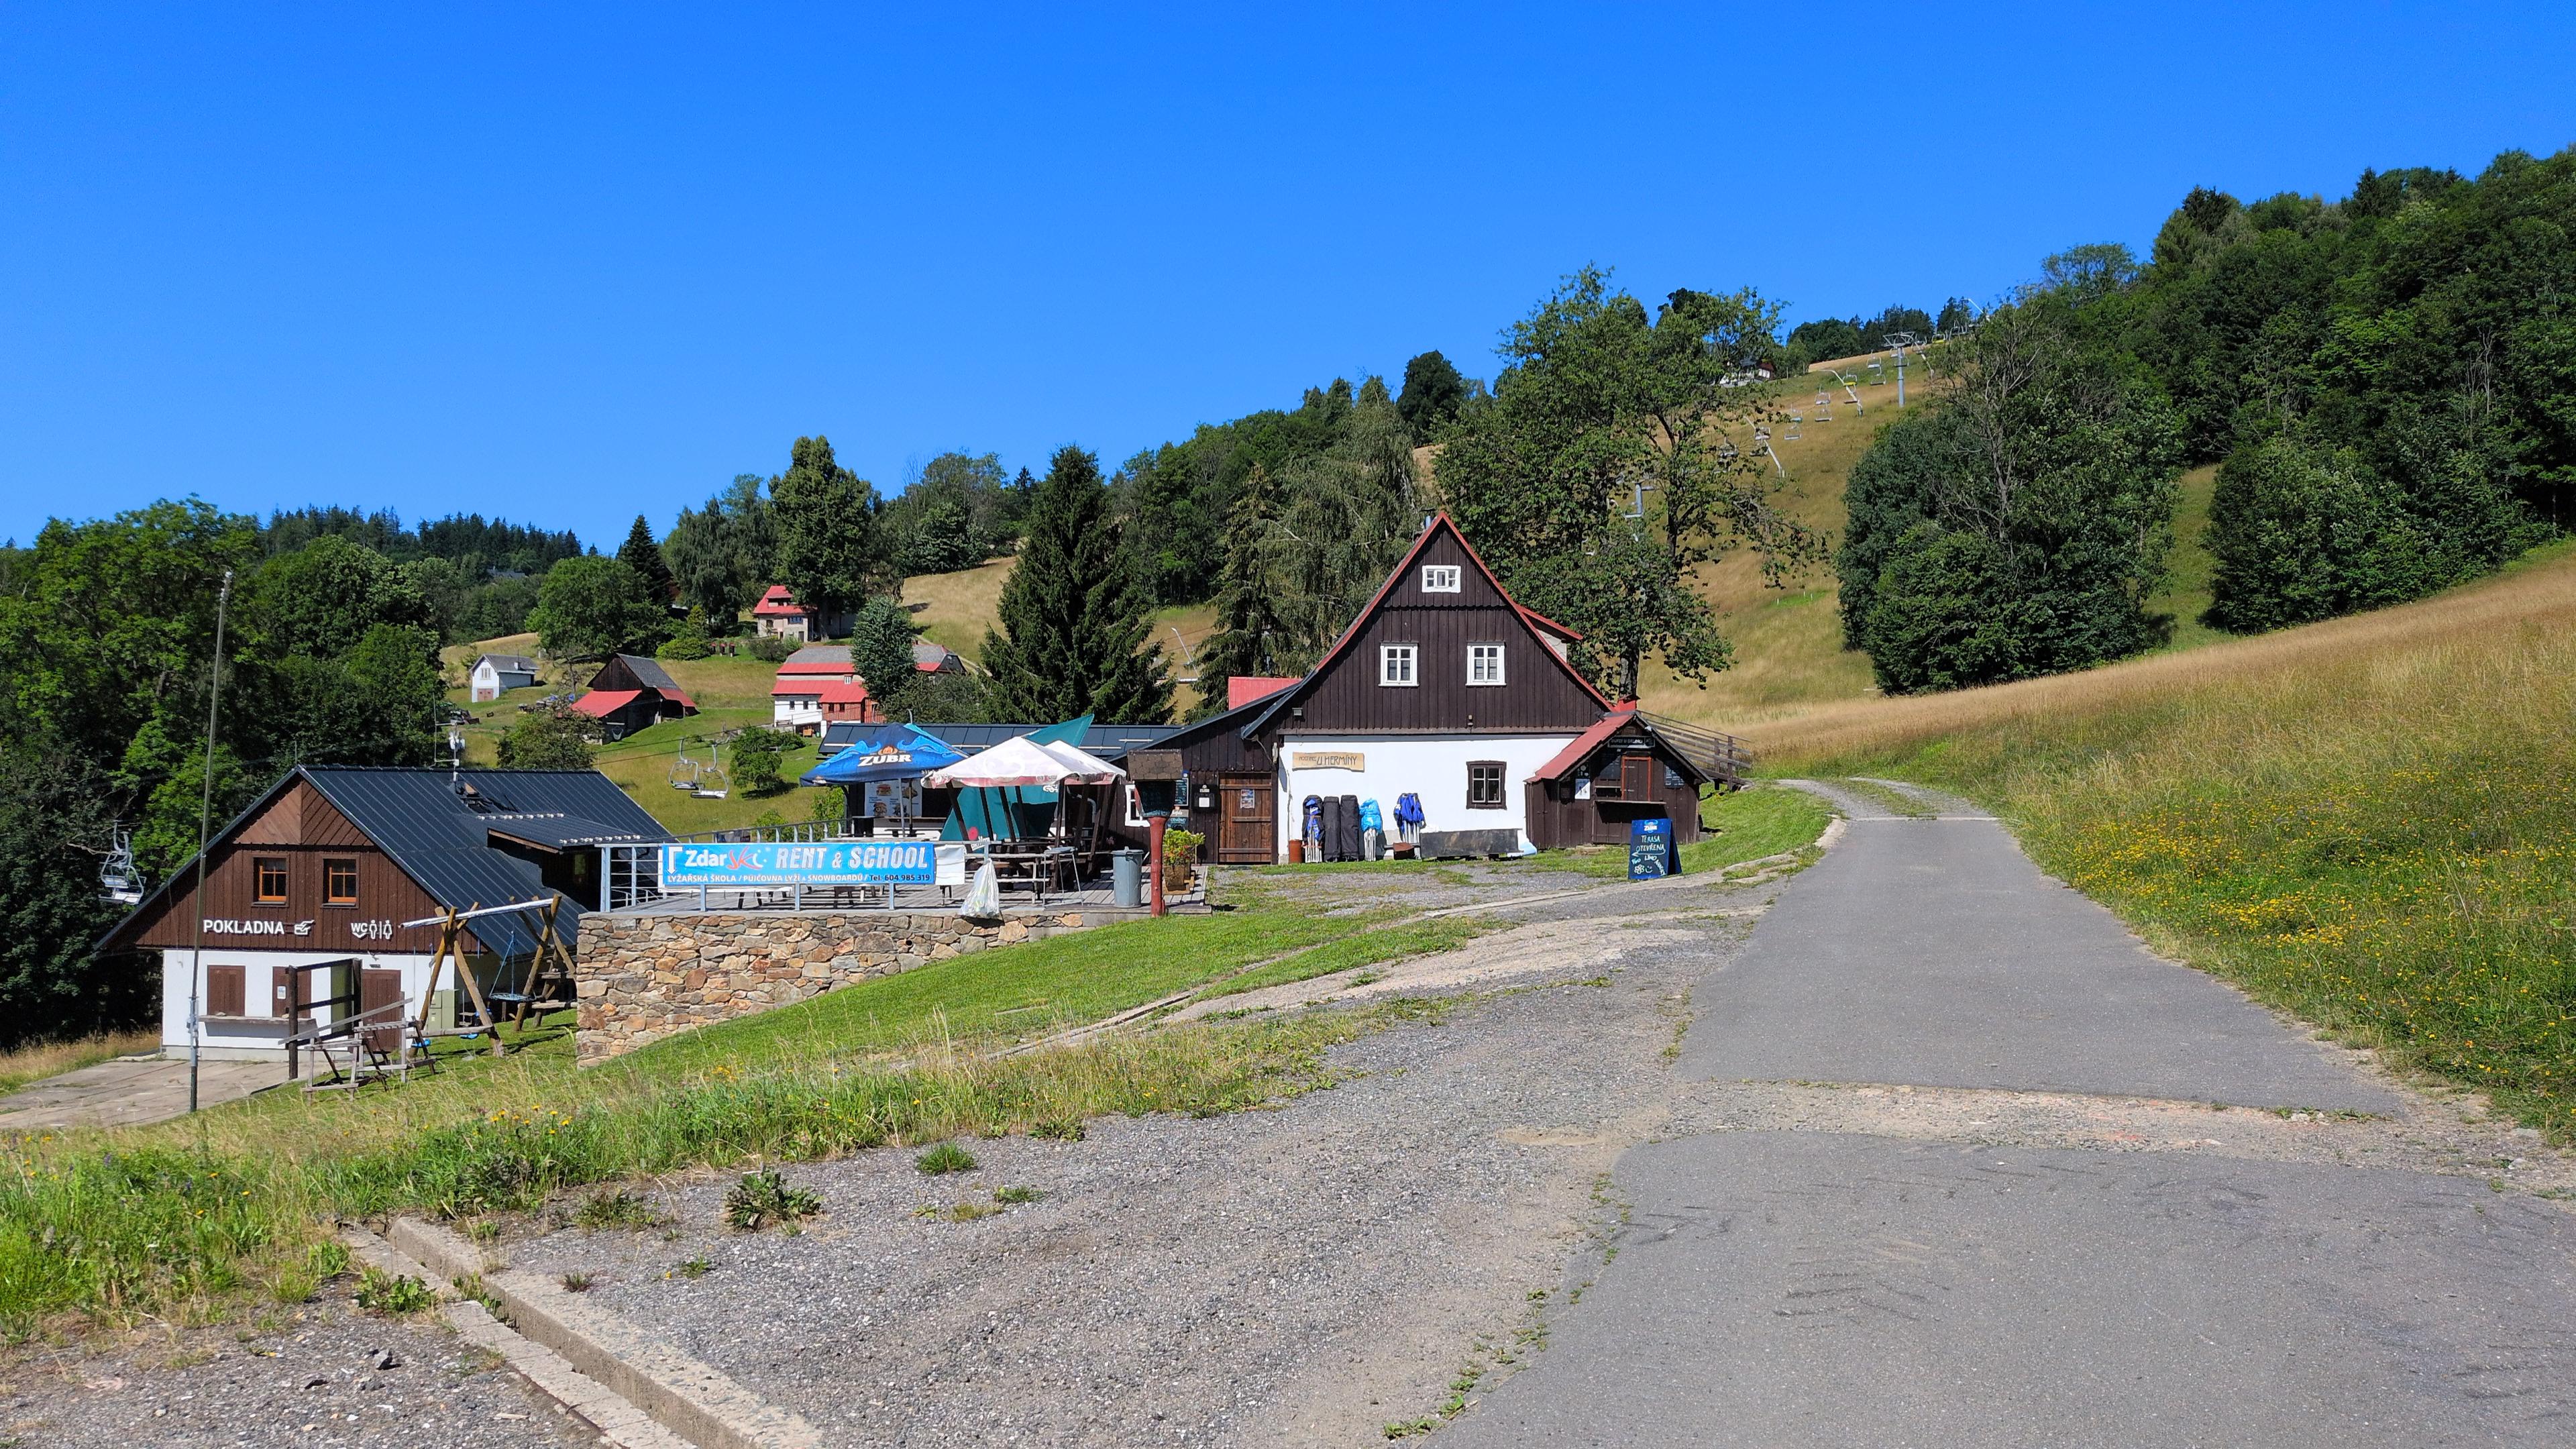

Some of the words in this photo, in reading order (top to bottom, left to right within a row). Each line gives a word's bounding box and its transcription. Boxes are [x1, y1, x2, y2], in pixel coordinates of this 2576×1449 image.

[857, 754, 912, 767] ZUBR
[1641, 835, 1660, 843] TERASA
[775, 847, 826, 869] RENT
[832, 852, 842, 869] &
[849, 846, 928, 869] SCHOOL
[711, 873, 736, 882] ŠKOLA
[203, 920, 284, 934] POKLADNA
[351, 922, 368, 932] WC
